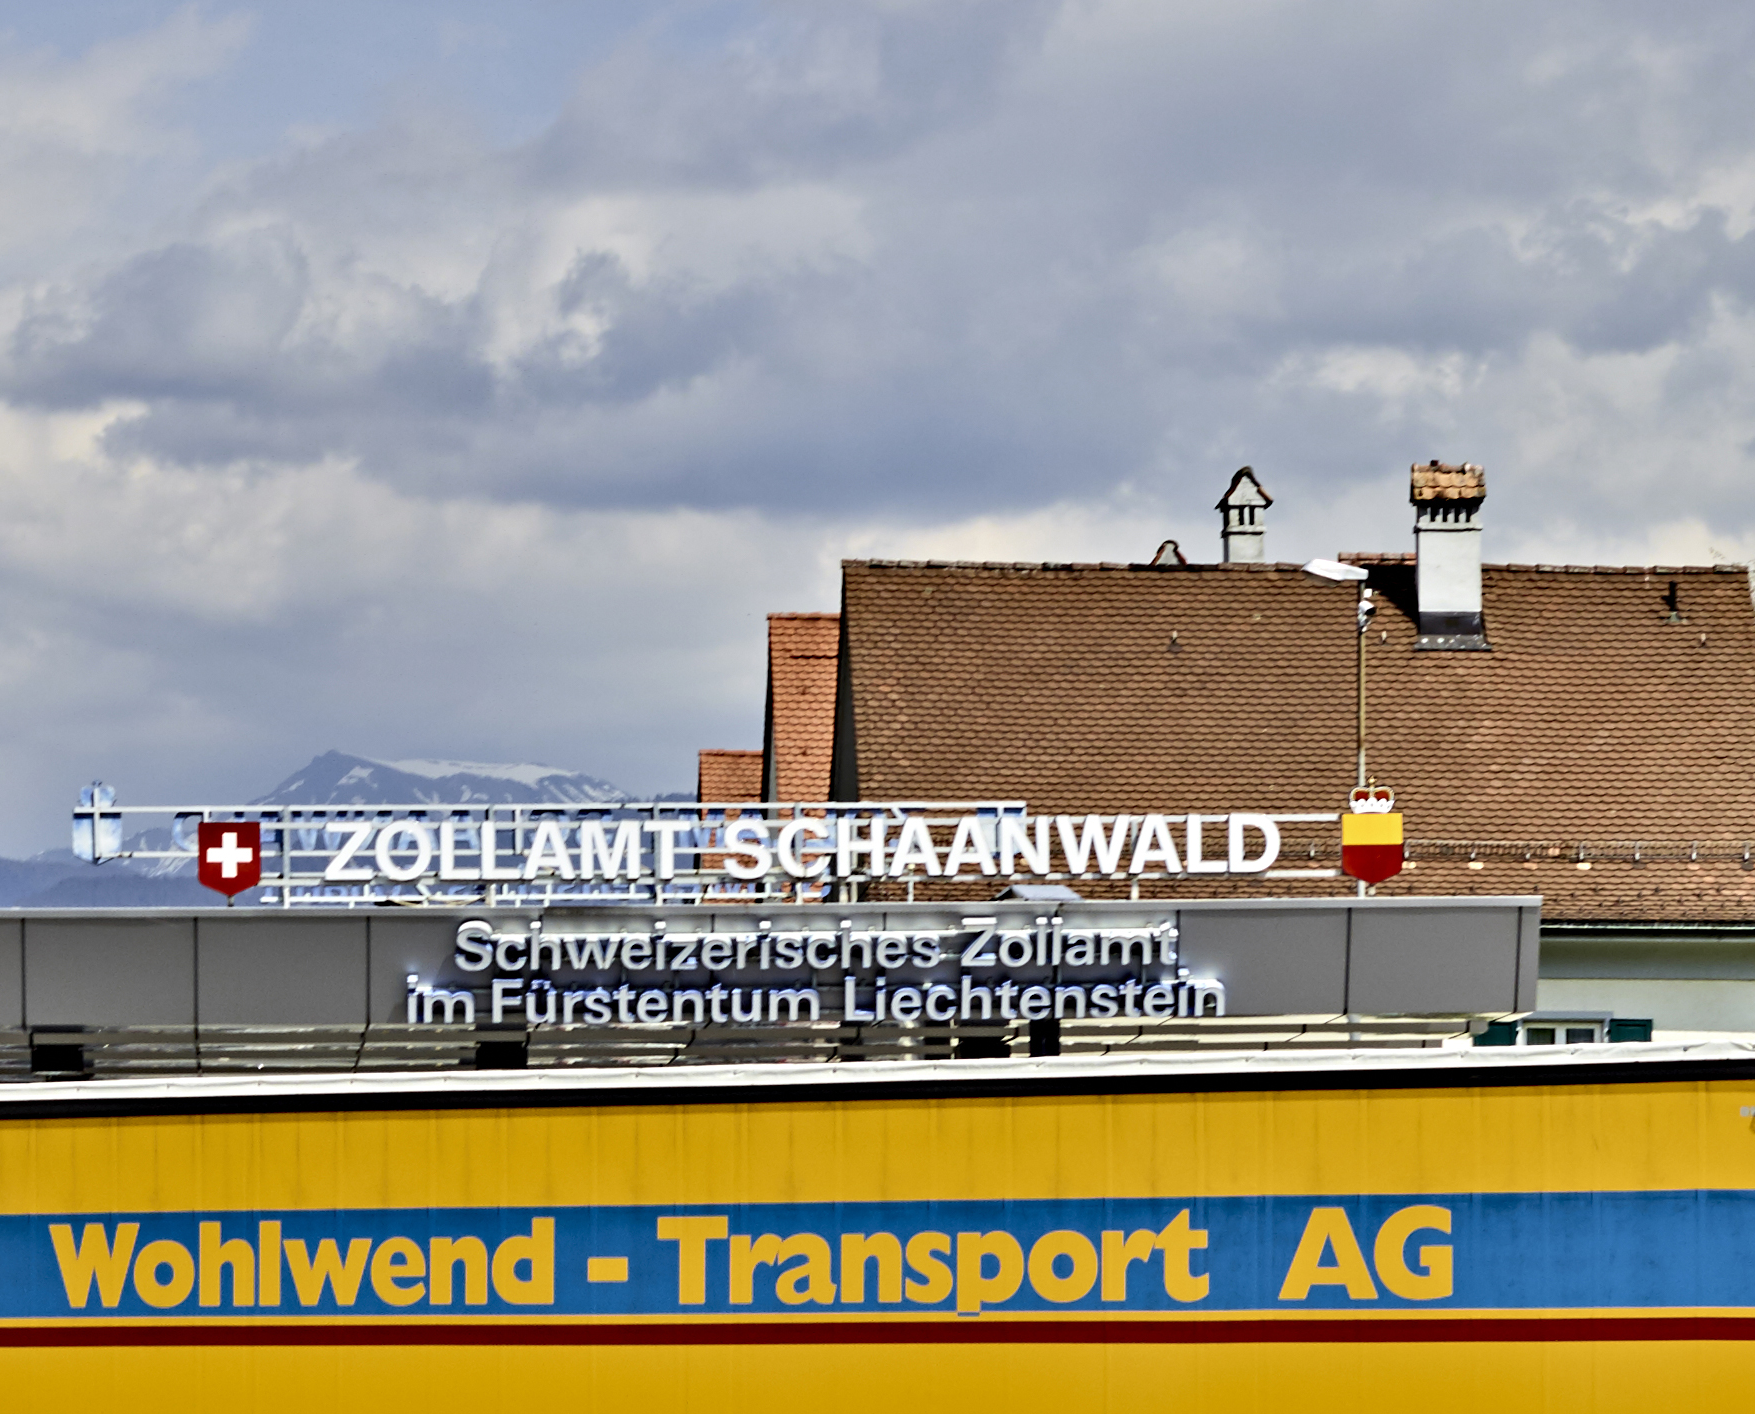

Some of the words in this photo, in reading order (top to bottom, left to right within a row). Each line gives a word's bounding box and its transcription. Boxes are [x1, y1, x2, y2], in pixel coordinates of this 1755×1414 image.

[325, 820, 691, 881] ZOLLAMT
[724, 814, 1281, 880] SCHAANWALD
[456, 918, 940, 973] Schweizerisches
[962, 917, 1177, 968] Zollamt
[406, 973, 475, 1025] im
[492, 977, 820, 1025] Fürstentum
[845, 970, 1226, 1022] Liechtenstein
[49, 1216, 555, 1309] Wohlwend
[657, 1208, 1210, 1317] Transport
[1278, 1205, 1454, 1301] AG
